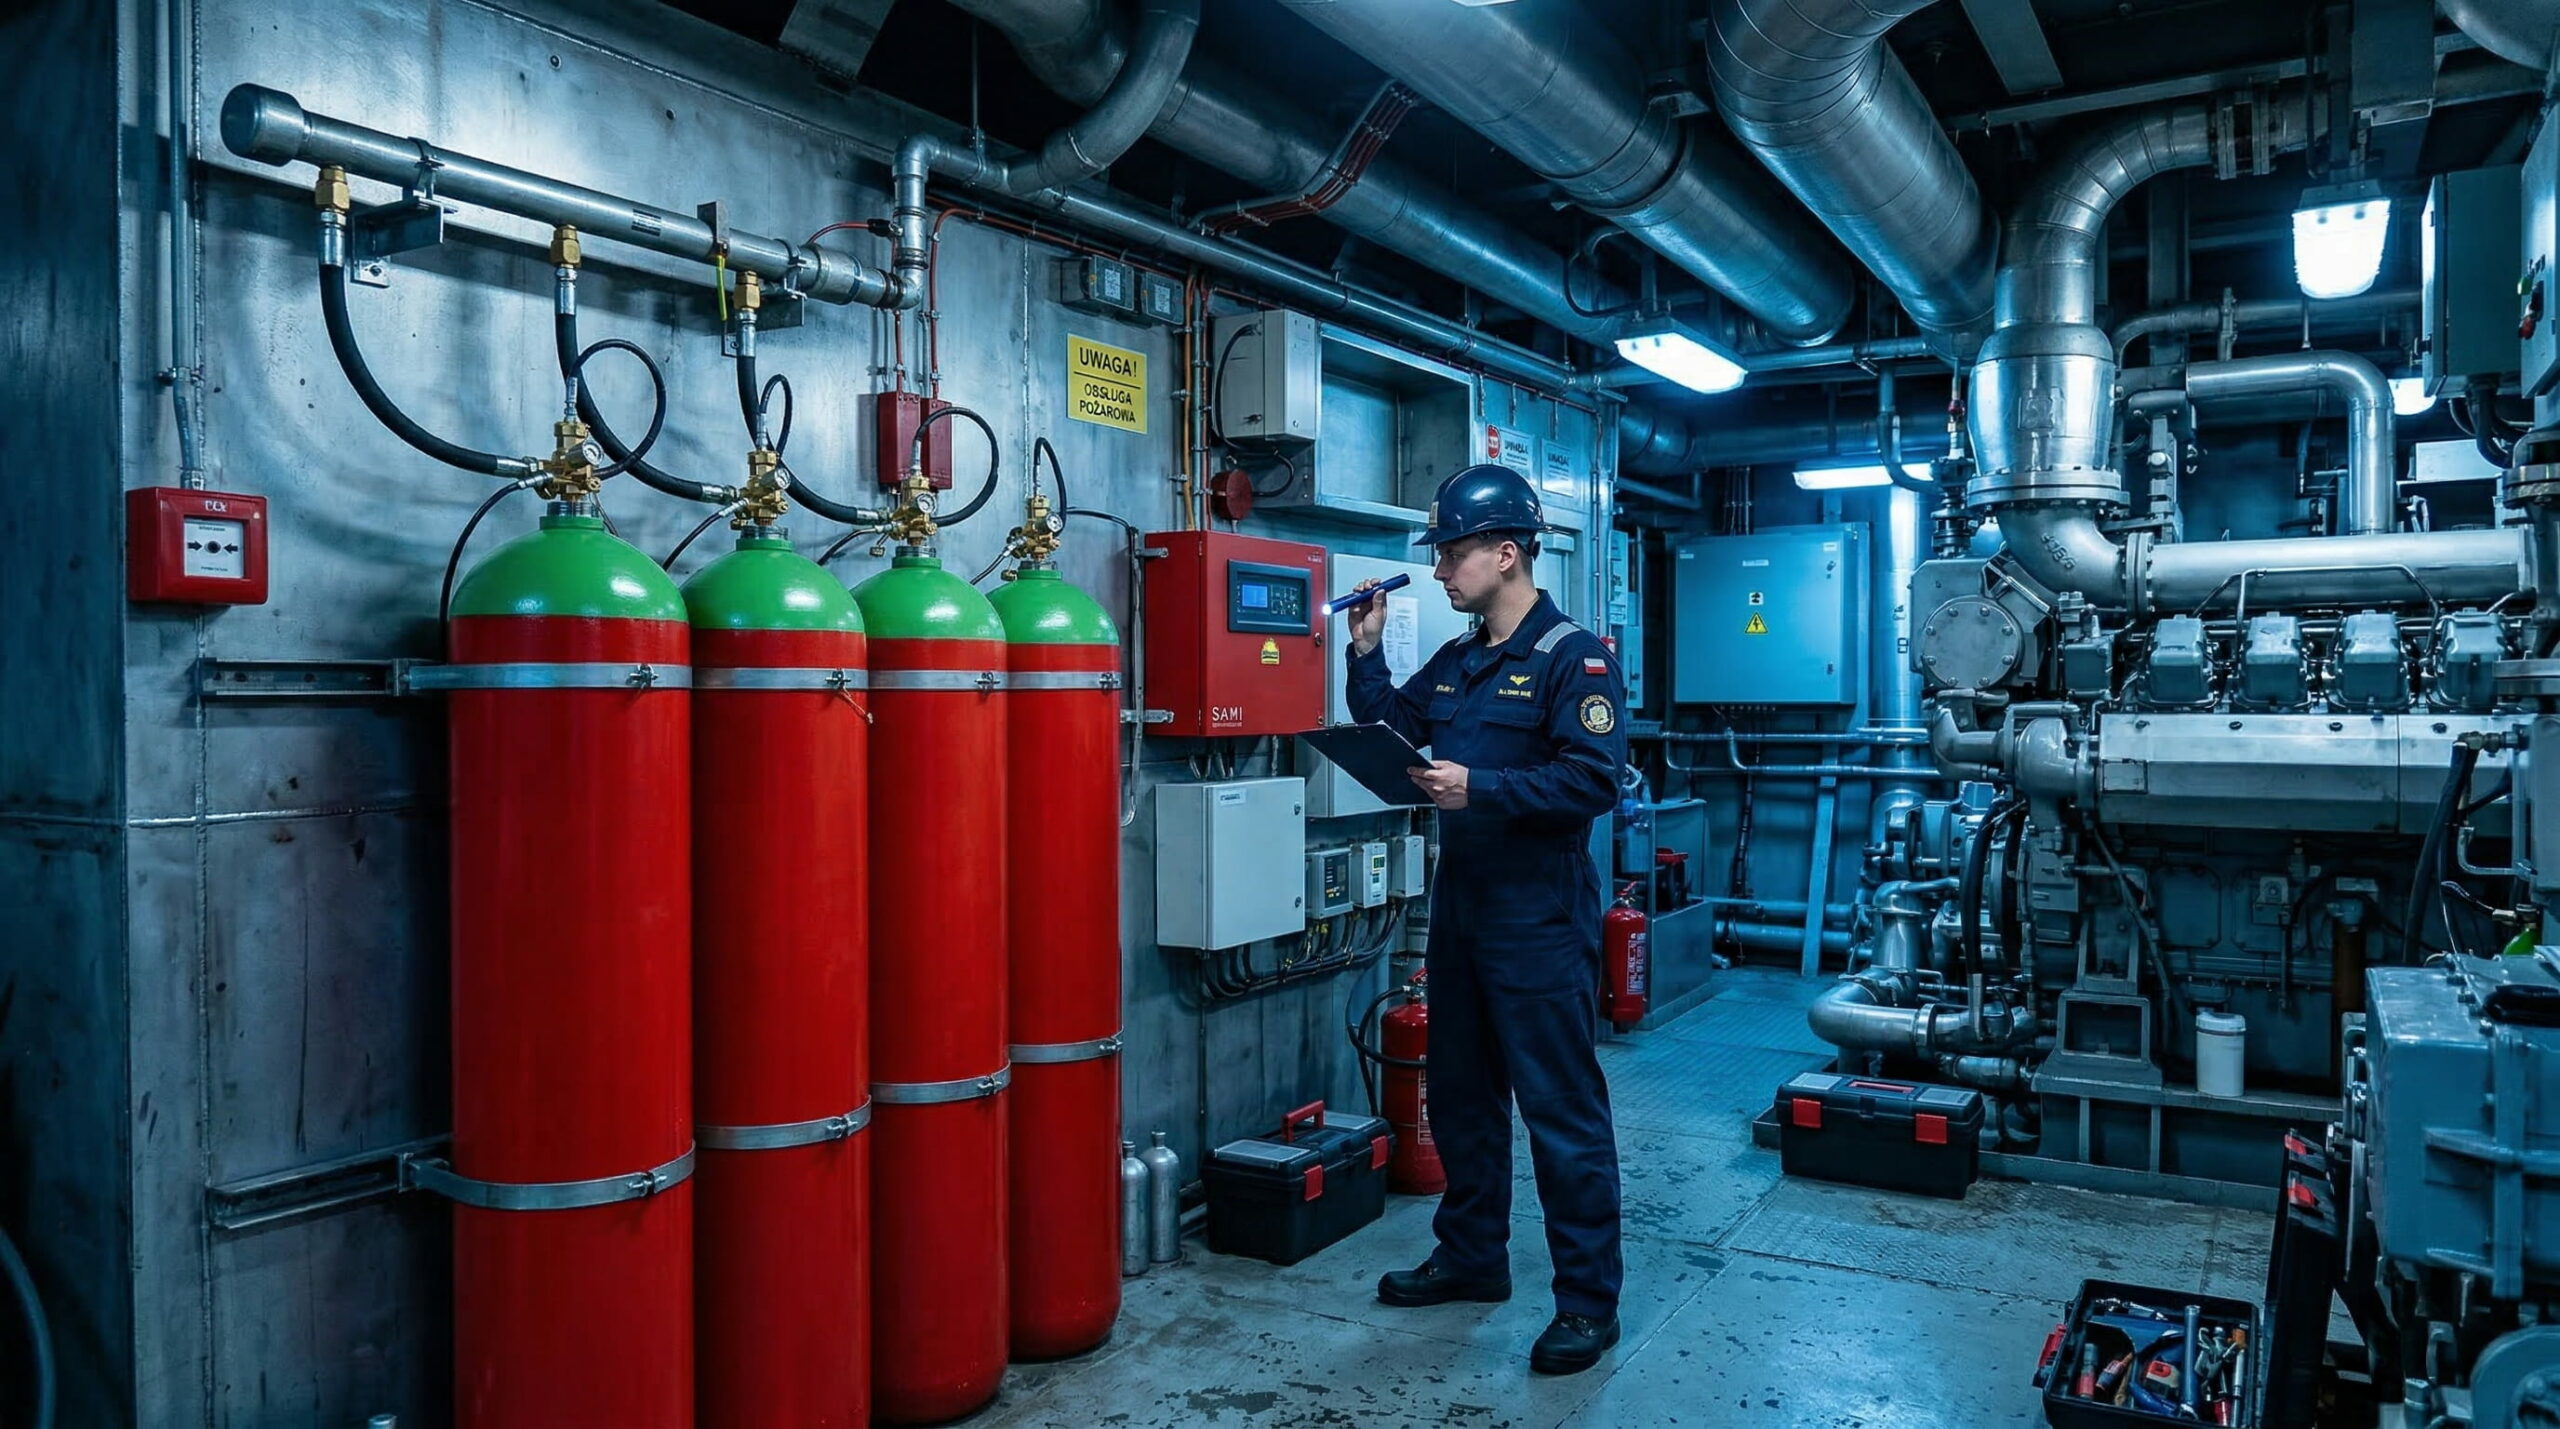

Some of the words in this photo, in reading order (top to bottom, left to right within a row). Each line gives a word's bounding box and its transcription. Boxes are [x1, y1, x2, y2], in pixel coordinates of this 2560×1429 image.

[1080, 347, 1137, 377] UWAGA!
[1080, 400, 1136, 423] POŻAROWA
[1212, 706, 1242, 721] SAMI
